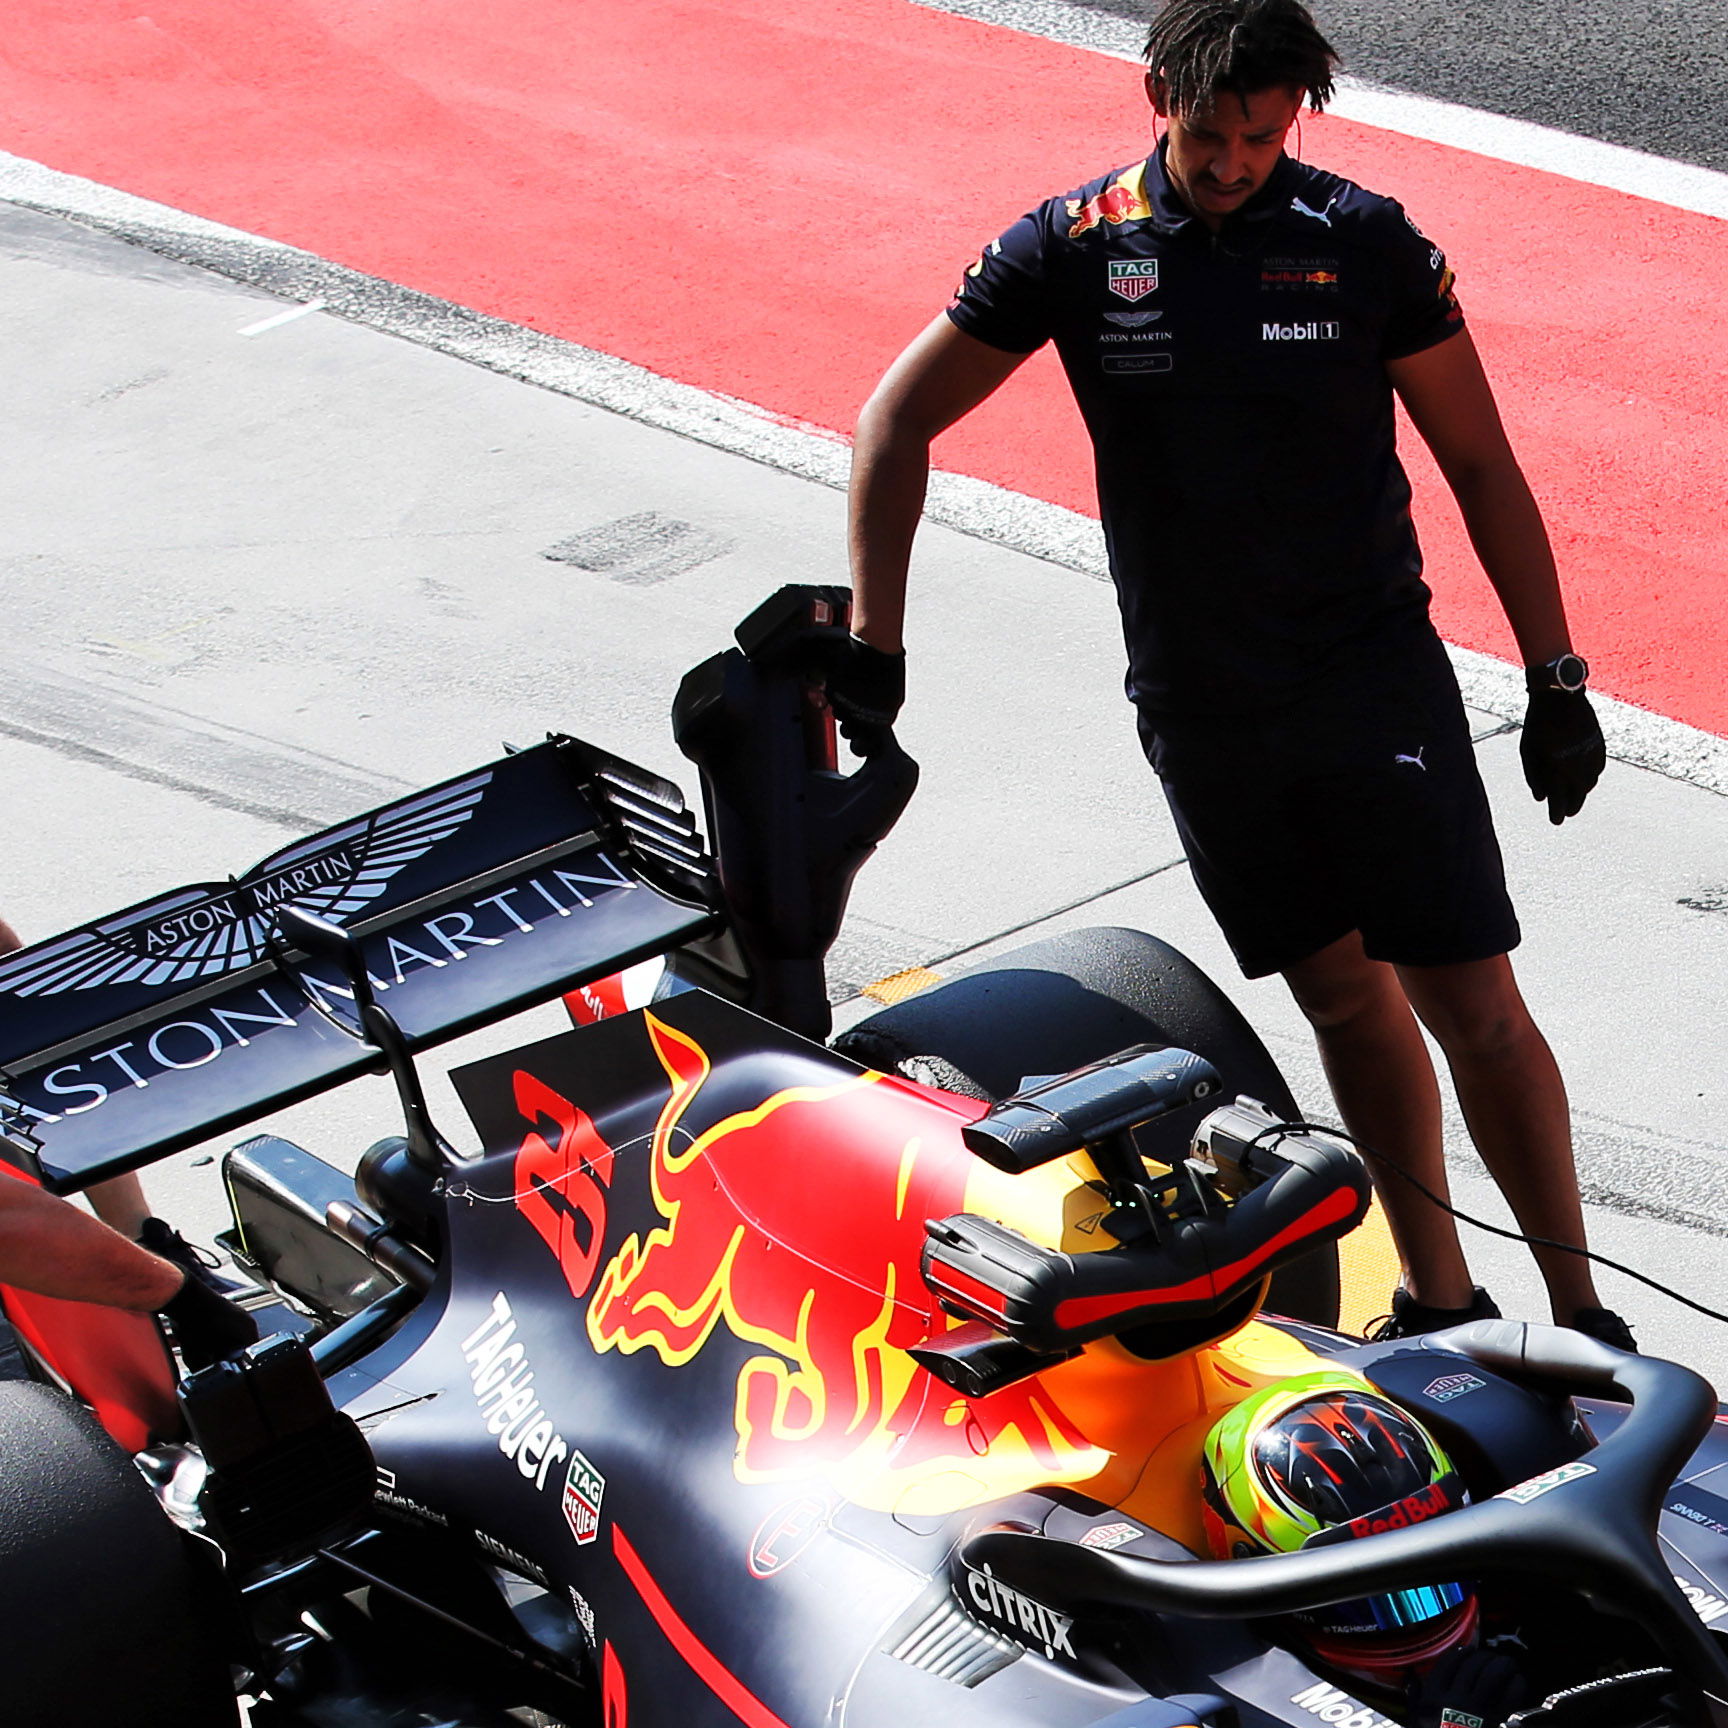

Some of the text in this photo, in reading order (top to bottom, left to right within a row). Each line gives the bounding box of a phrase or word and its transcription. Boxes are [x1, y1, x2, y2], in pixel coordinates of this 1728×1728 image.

[1112, 262, 1153, 276] TAG
[1112, 278, 1155, 299] HEUER
[1100, 331, 1173, 343] ASTON MARTIN
[1262, 322, 1318, 340] Mobil
[145, 851, 353, 955] ASTON MARTIN
[299, 852, 640, 1007] MARTIN
[574, 1461, 600, 1503] TAG
[564, 1489, 598, 1536] HEUER
[474, 1528, 550, 1587] SIEMENS
[967, 1561, 1079, 1662] CITRIX
[1447, 1712, 1478, 1728] TAG
